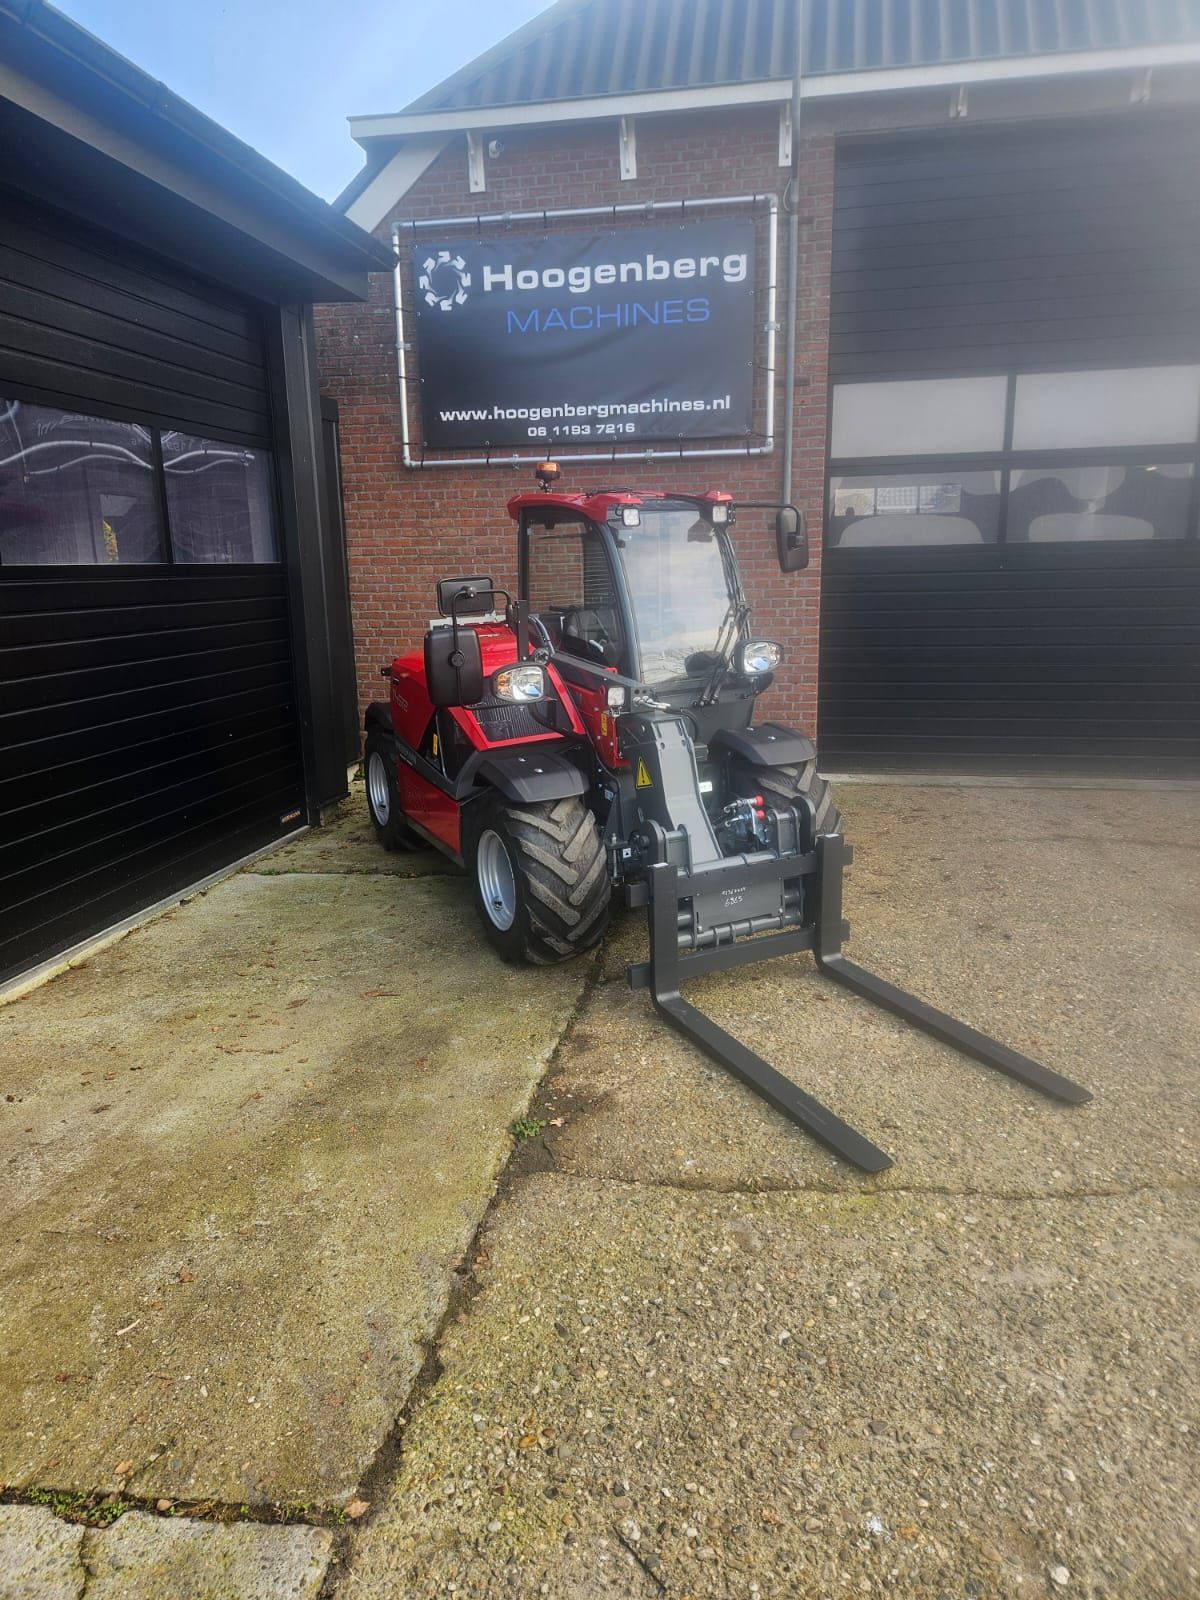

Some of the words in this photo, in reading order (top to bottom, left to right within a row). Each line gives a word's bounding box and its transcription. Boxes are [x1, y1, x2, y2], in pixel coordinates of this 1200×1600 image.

[483, 254, 747, 293] Hoogenberg
[507, 298, 710, 333] MACHINES
[439, 395, 731, 422] www.hoogenbergmachines.nl
[527, 426, 547, 437] 06
[553, 425, 591, 436] 1193
[596, 422, 636, 435] 7216
